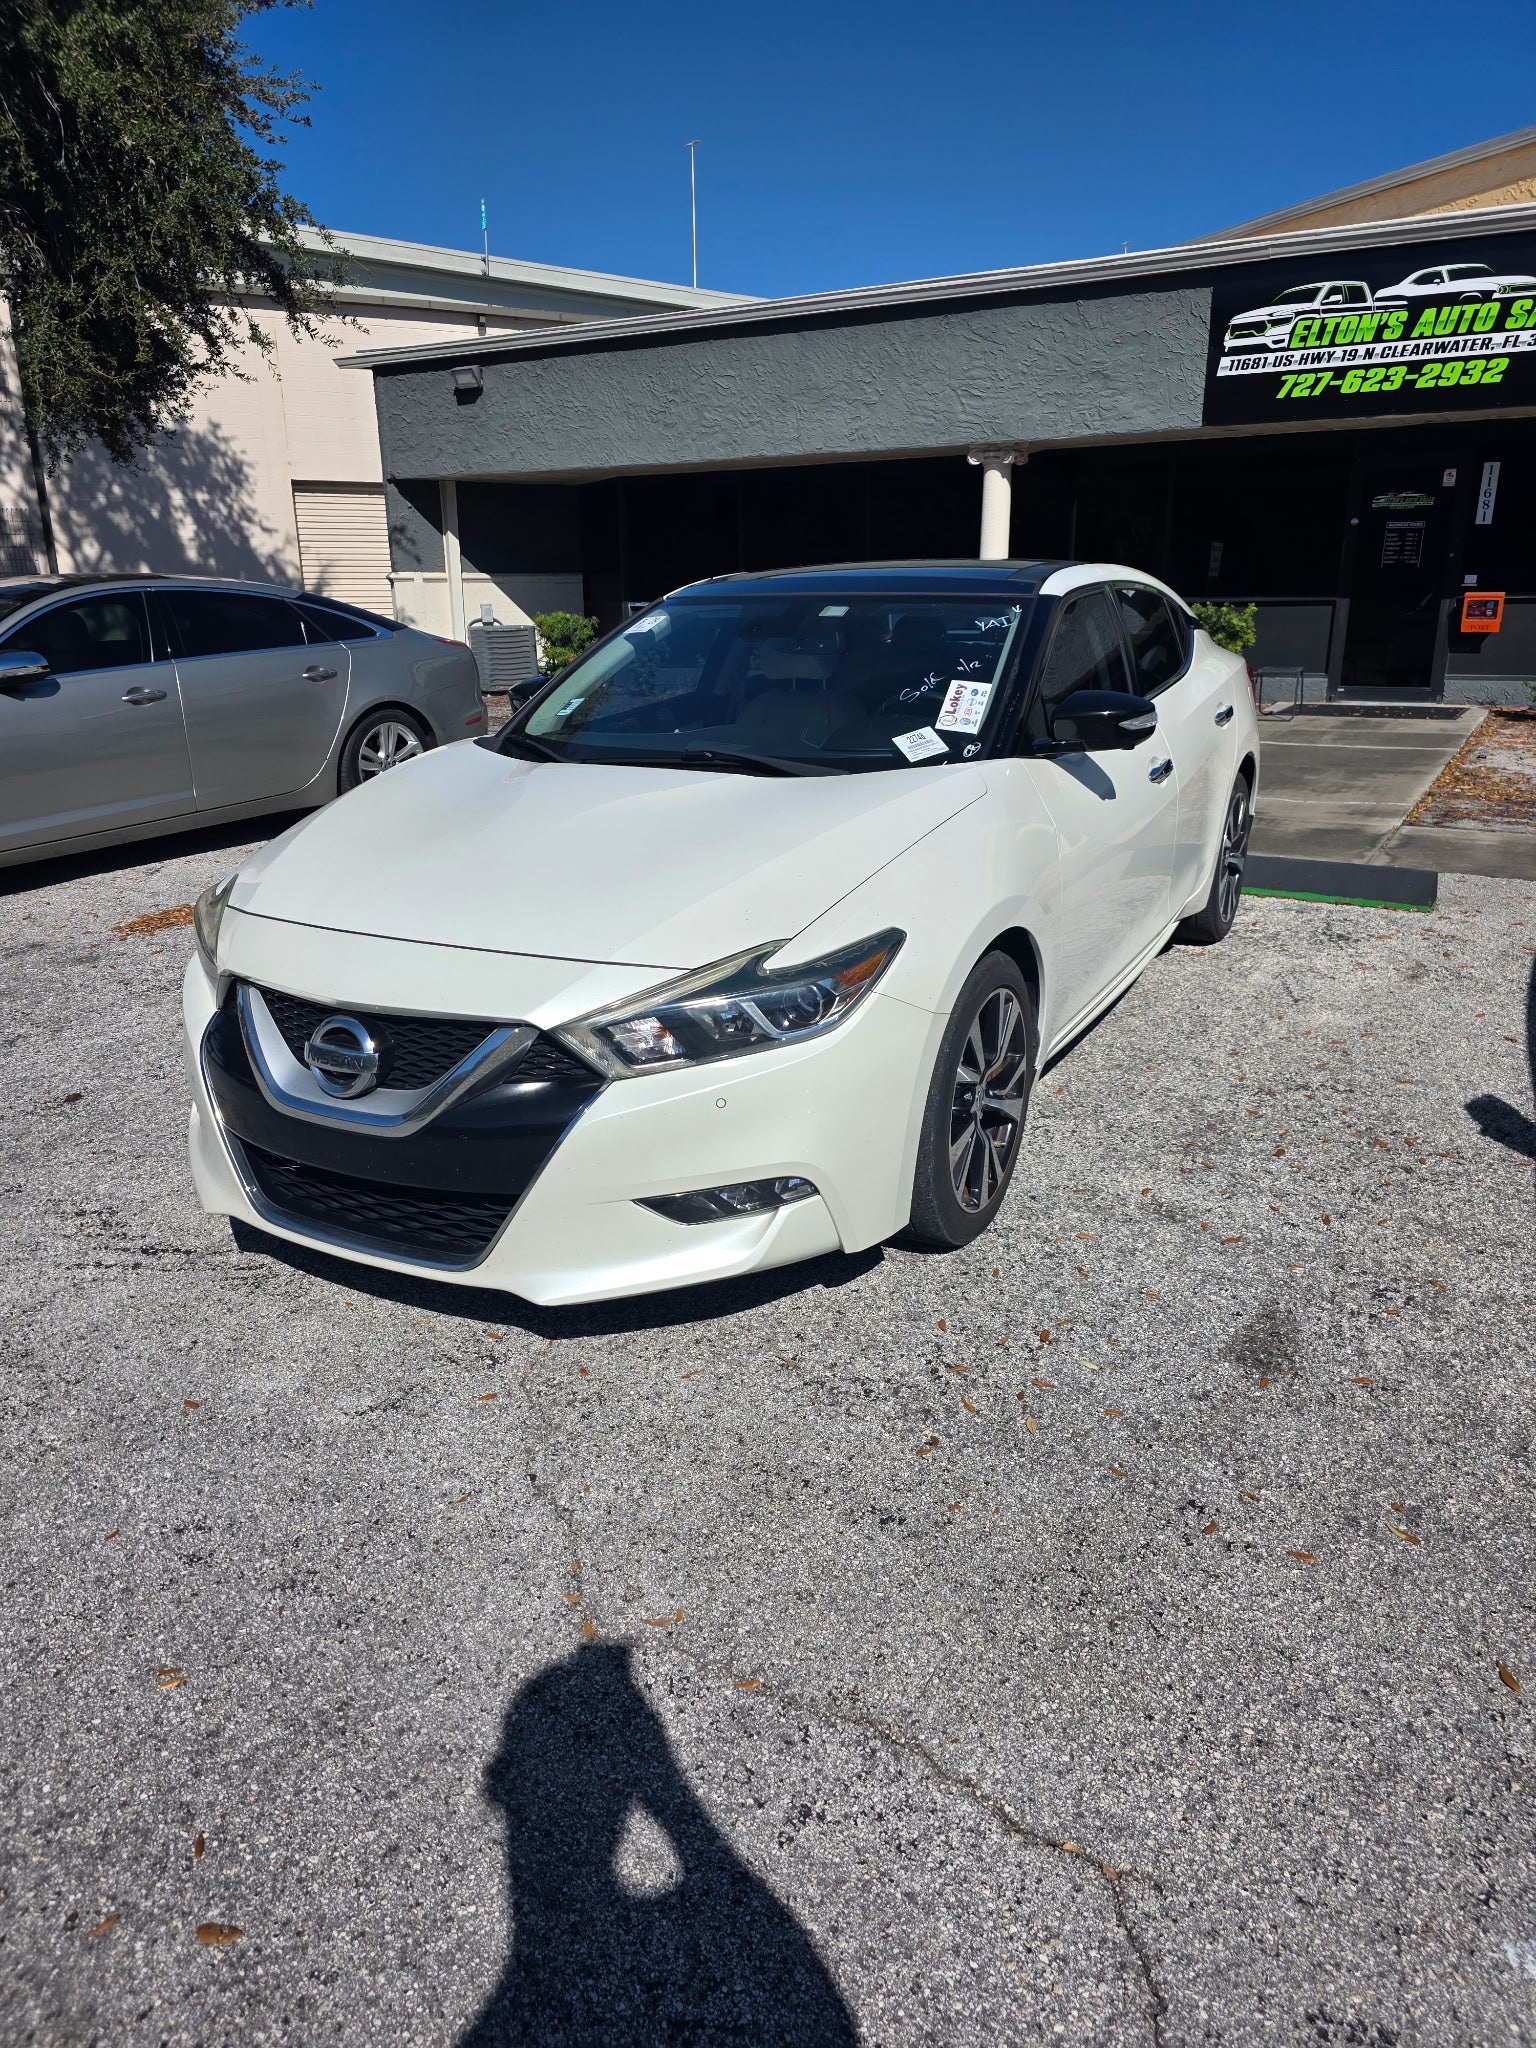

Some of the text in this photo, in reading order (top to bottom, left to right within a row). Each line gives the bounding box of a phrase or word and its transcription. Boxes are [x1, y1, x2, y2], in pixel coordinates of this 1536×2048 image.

[1290, 311, 1408, 348] ELTON'S
[1410, 302, 1500, 338] AUTO
[1228, 357, 1269, 372] 11681
[1272, 355, 1294, 368] US
[1297, 351, 1336, 366] HWY
[1339, 349, 1358, 362] 19
[1361, 348, 1376, 360] N
[1379, 337, 1494, 359] CLEARWATER,
[1502, 335, 1520, 348] FL
[1276, 358, 1510, 398] 727-623-2932
[945, 684, 967, 714] Lokey
